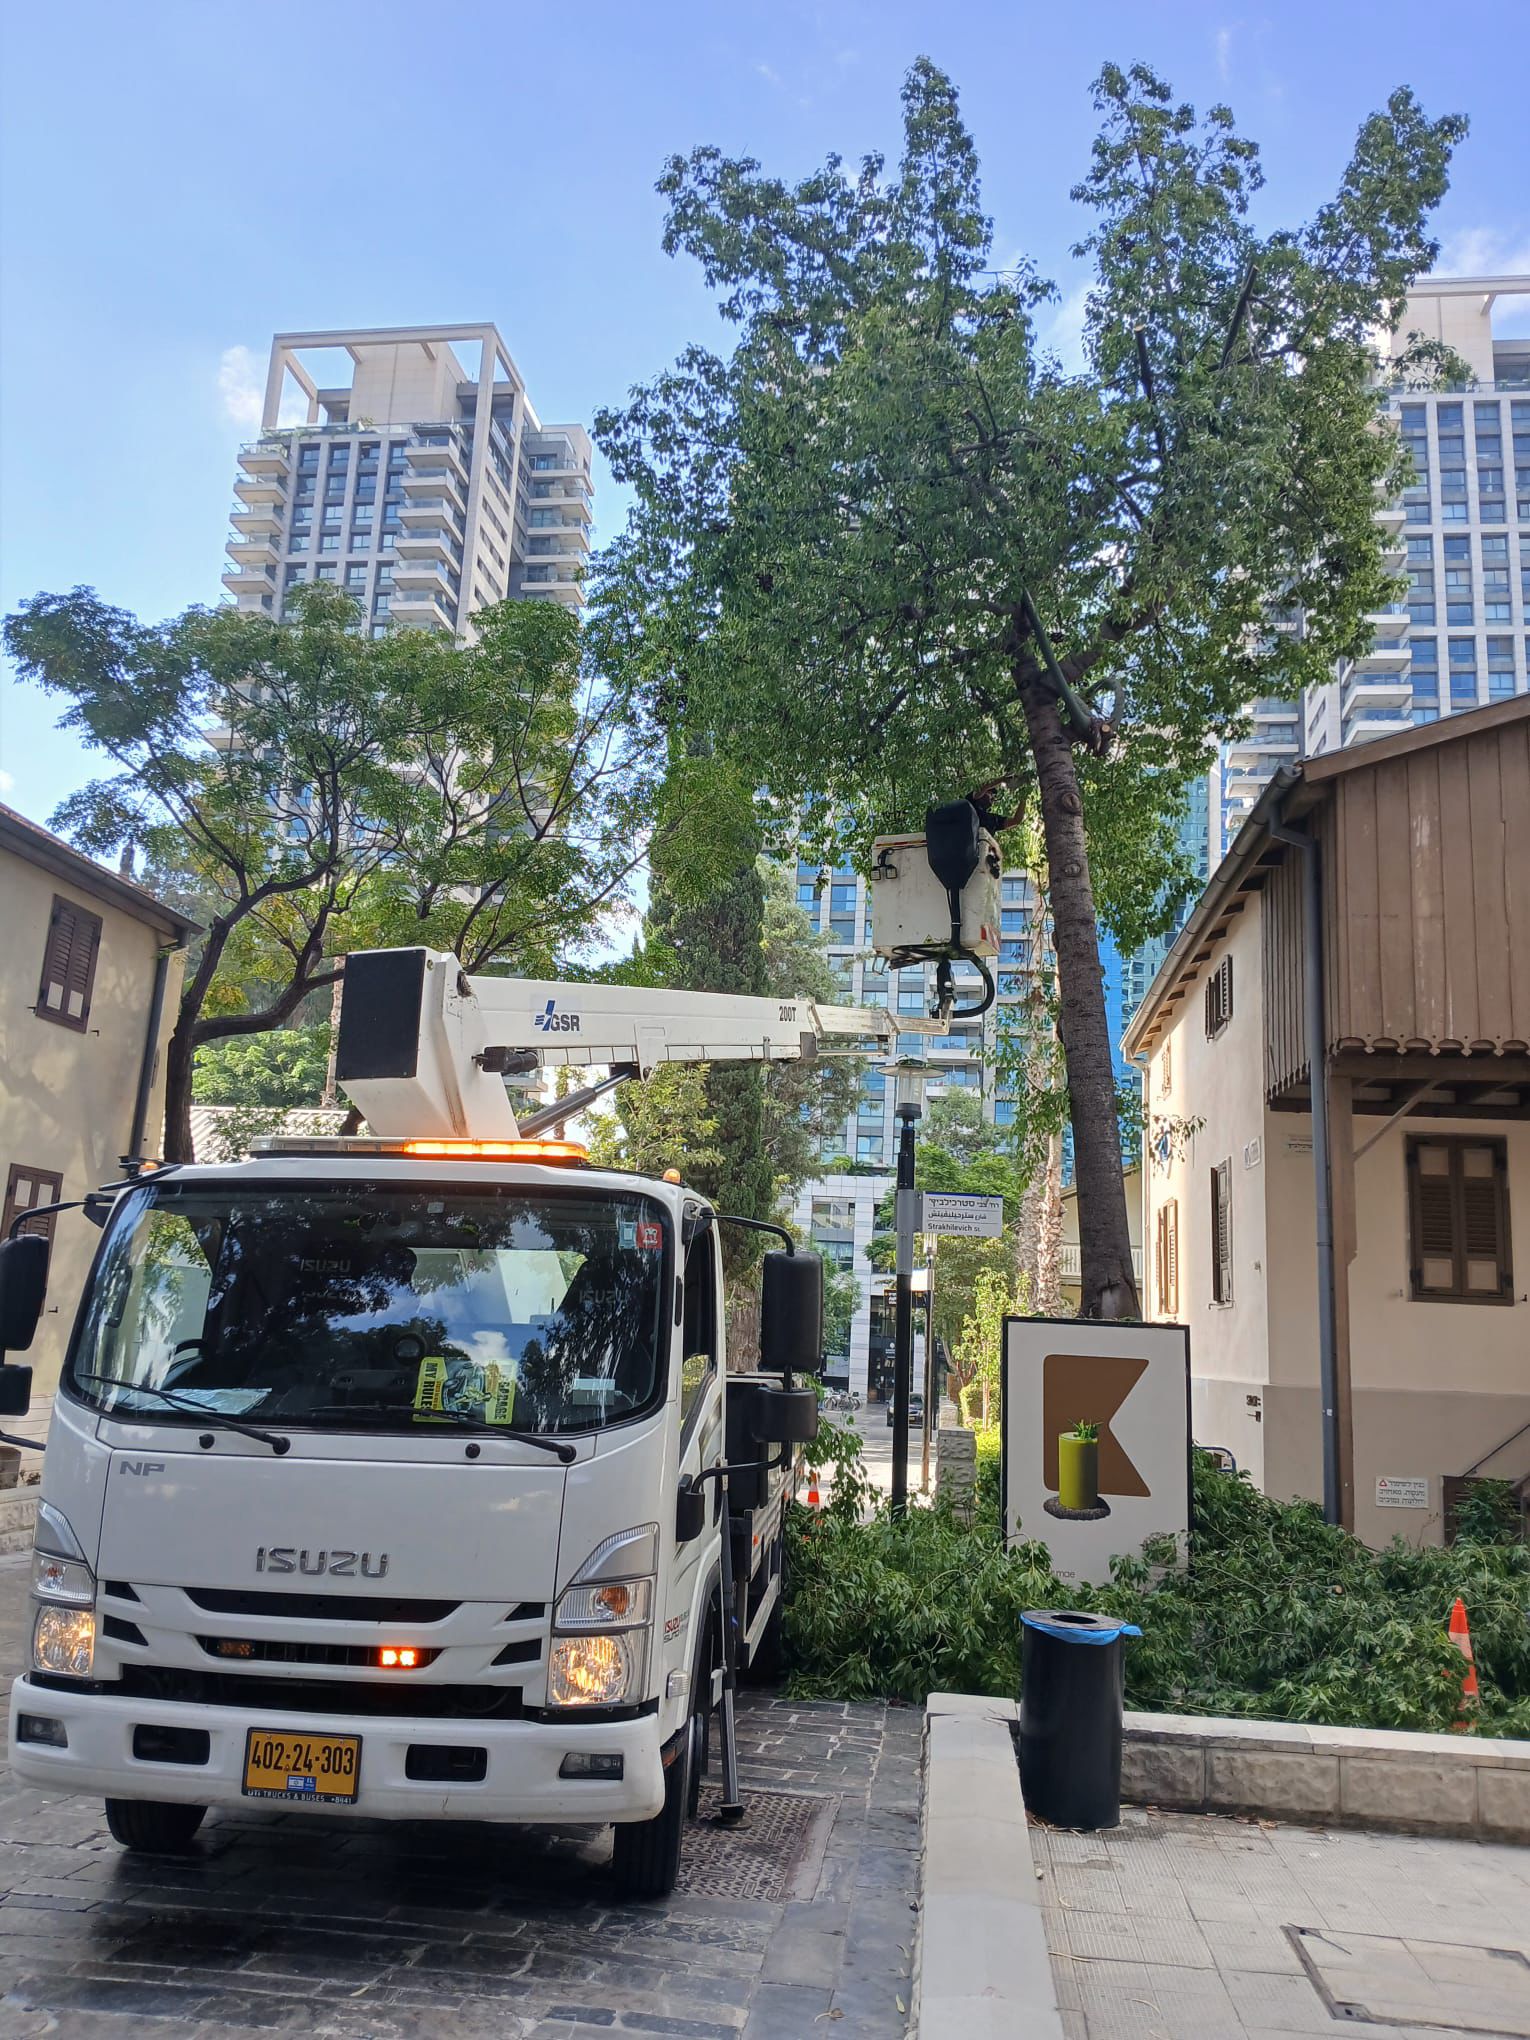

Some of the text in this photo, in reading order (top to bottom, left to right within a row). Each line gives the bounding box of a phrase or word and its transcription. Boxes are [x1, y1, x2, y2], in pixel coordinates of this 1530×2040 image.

[779, 1006, 797, 1022] 200T
[550, 1014, 580, 1032] GSR
[928, 1223, 972, 1232] Strakhilevich
[425, 1362, 438, 1379] MY
[119, 1461, 166, 1476] NP
[256, 1545, 390, 1578] ISUZU
[263, 1791, 292, 1800] TRUCKS
[301, 1793, 325, 1802] BUSES
